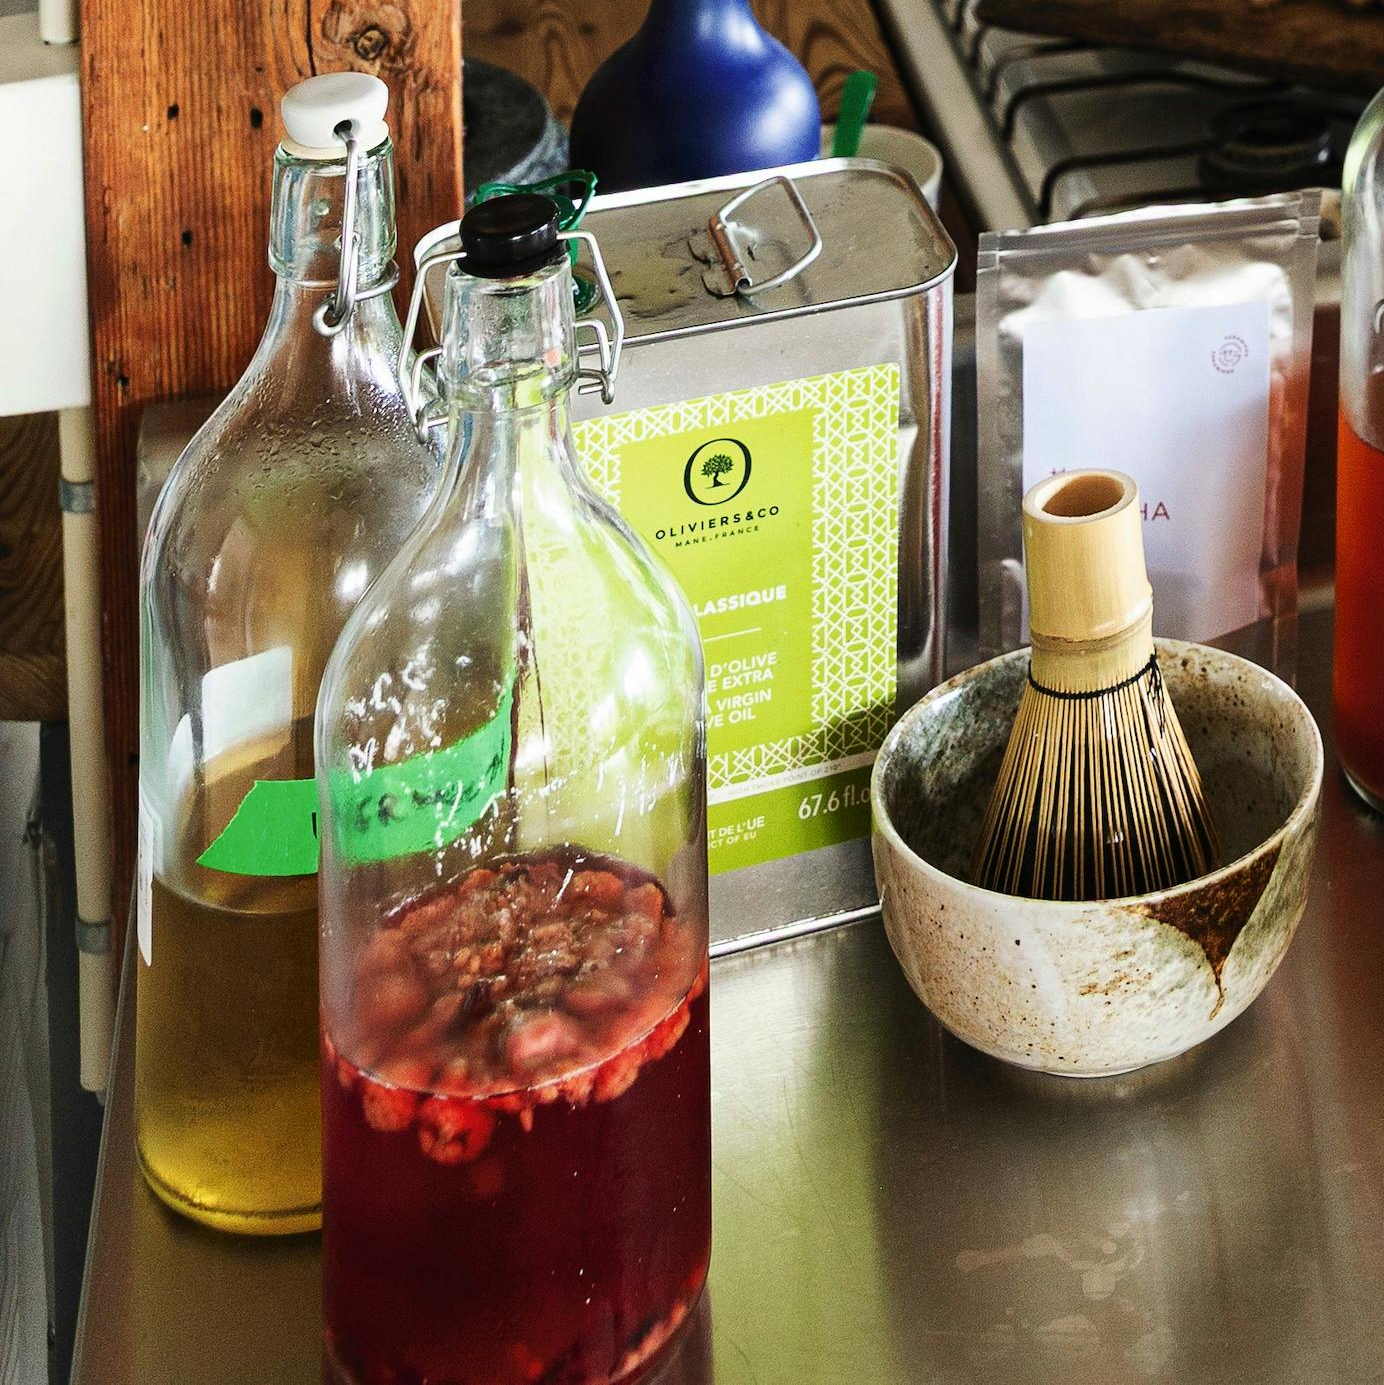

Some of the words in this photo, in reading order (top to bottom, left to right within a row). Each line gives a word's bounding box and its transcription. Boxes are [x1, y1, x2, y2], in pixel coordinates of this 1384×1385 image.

[655, 506, 779, 540] OLIVIERS&CO
[692, 584, 788, 617] LASSIQUE
[710, 651, 778, 679] D'OLIVE
[722, 668, 774, 691] EXTRA
[716, 688, 772, 713] VIRGIN
[728, 708, 756, 724] OIL
[798, 793, 840, 820] 67.6
[842, 783, 871, 808] fl.o
[718, 828, 736, 838] DE
[727, 834, 742, 846] OF
